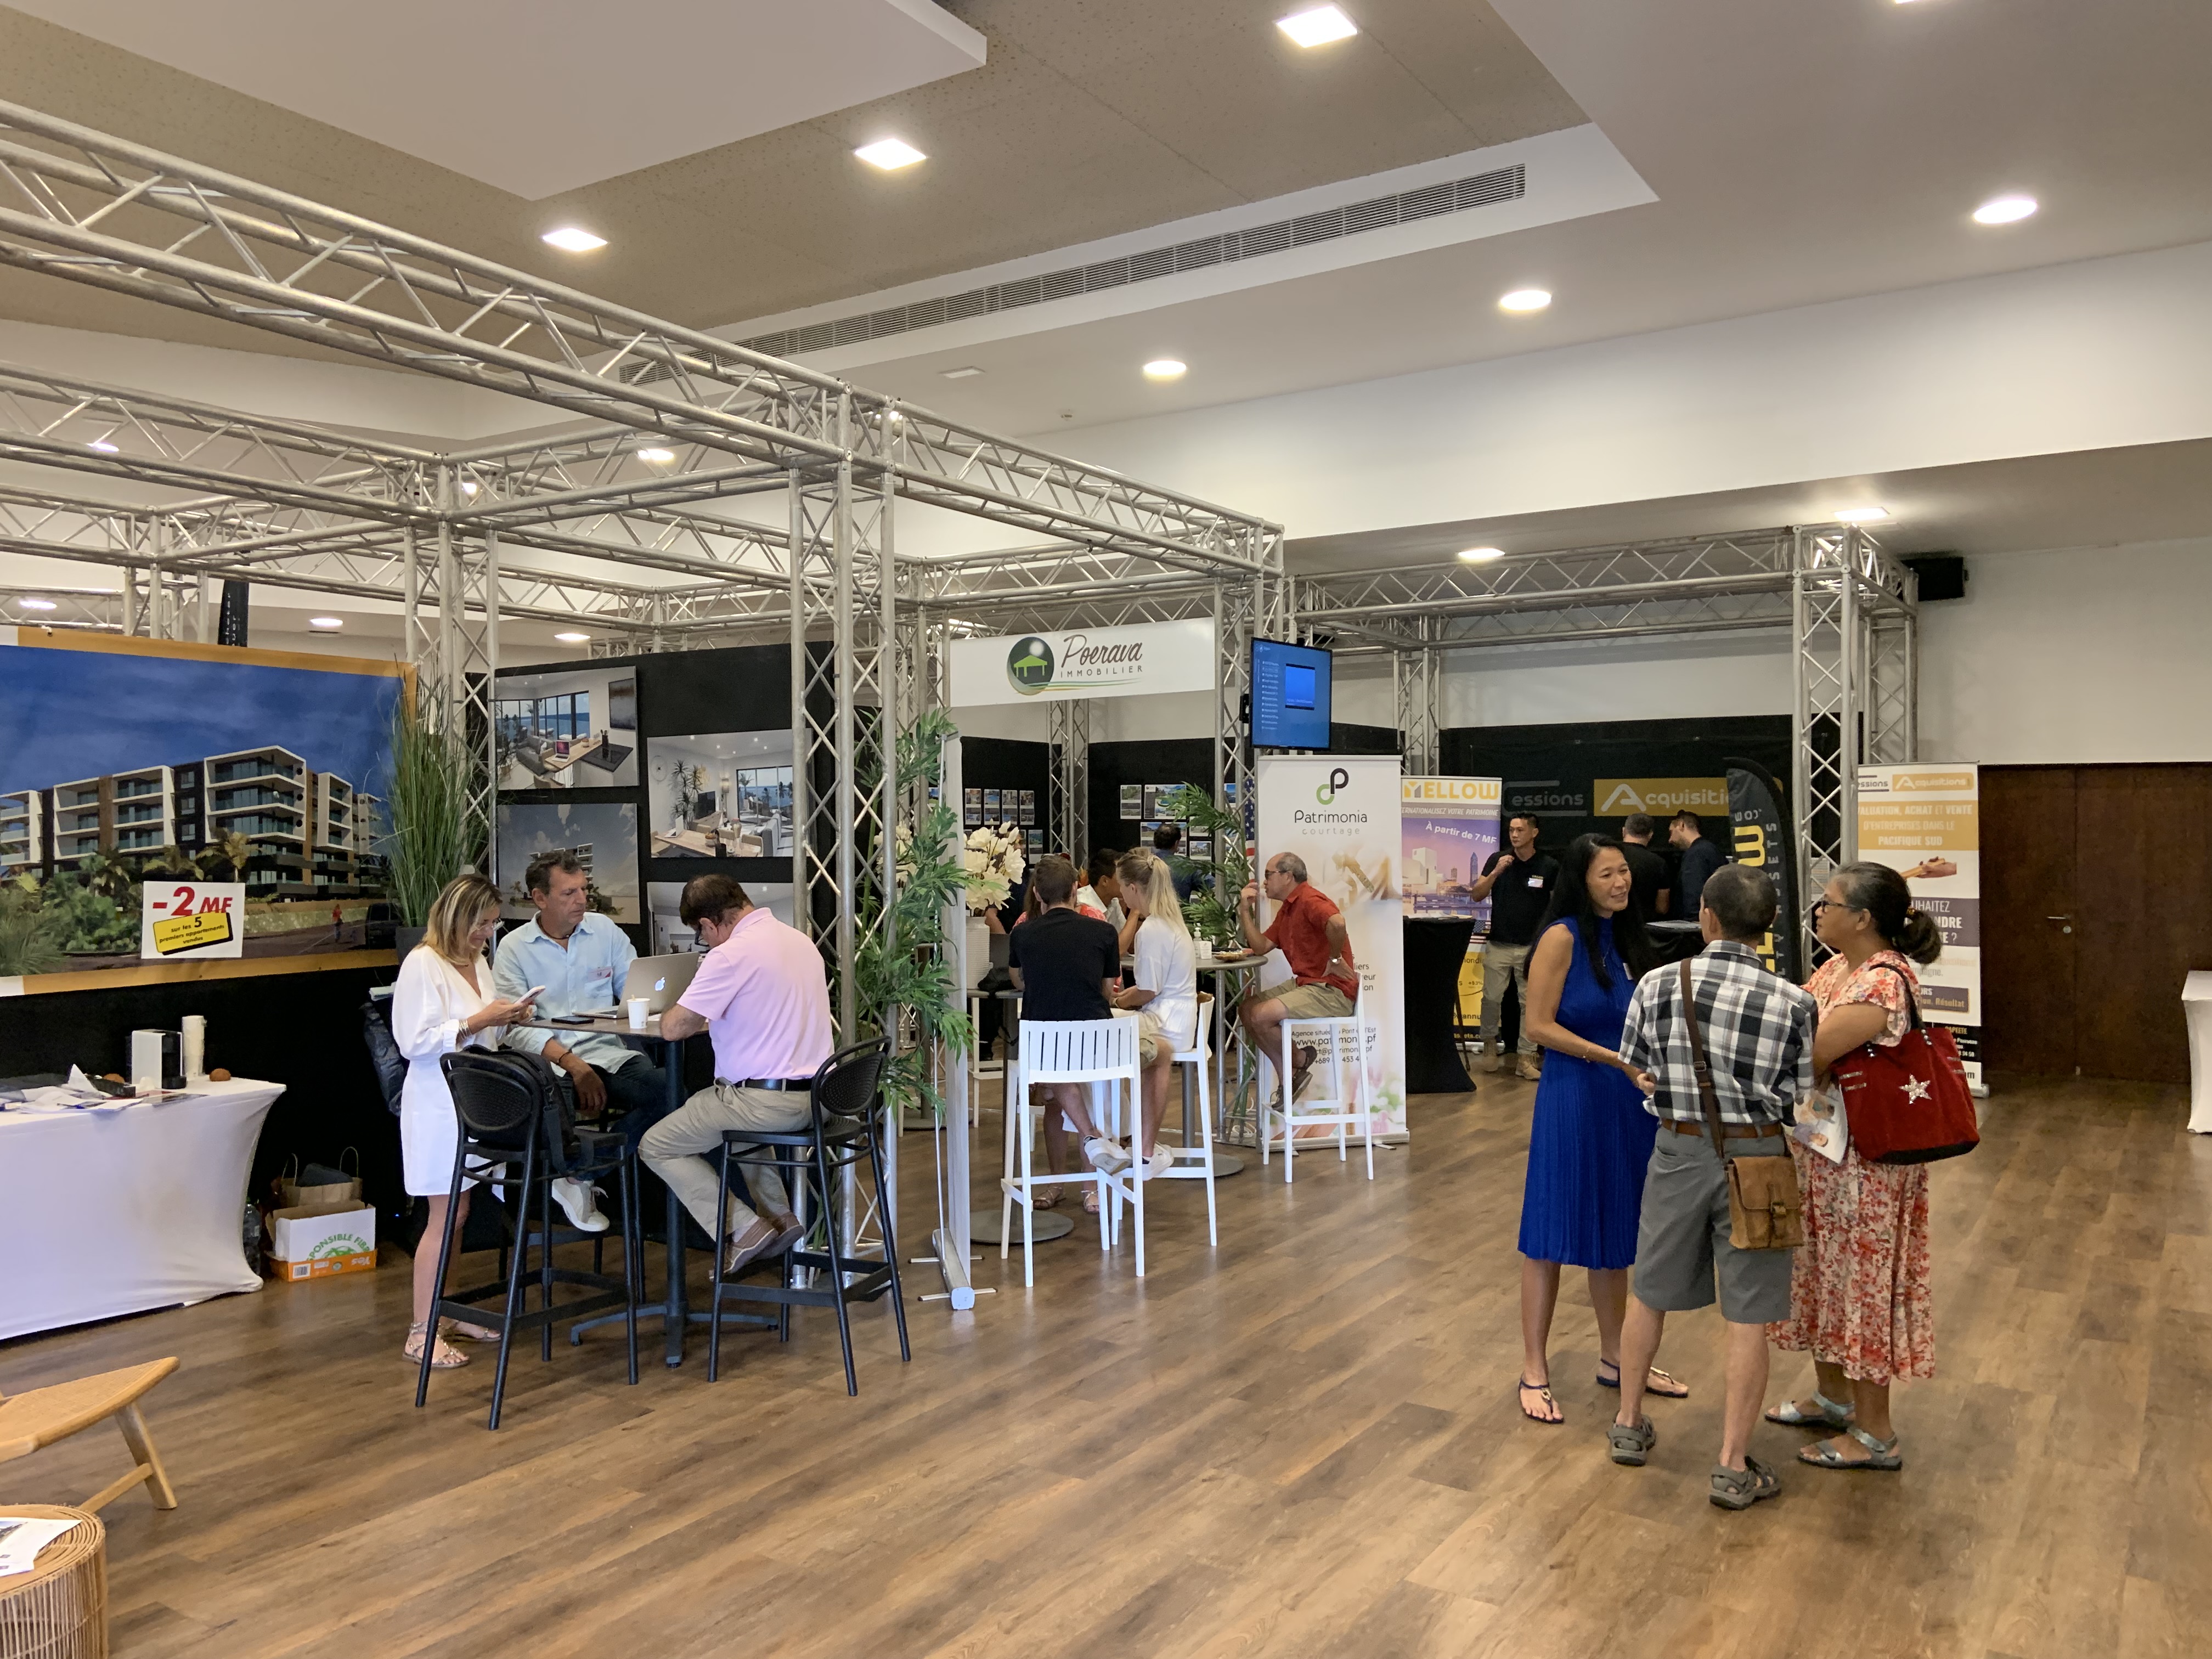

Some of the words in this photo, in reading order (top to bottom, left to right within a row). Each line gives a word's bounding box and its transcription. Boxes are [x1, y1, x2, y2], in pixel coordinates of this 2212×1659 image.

[1060, 634, 1142, 668] Poerava
[1060, 665, 1143, 678] IMMOBILIER
[1895, 776, 1966, 790] Acquisitions
[1404, 781, 1499, 800] YELLOW
[1601, 783, 1729, 812] Acquisiti
[1295, 809, 1368, 823] Patrimonia
[1905, 805, 1932, 815] ACHAT
[1946, 805, 1972, 815] VENTE
[1302, 827, 1360, 836] courtage
[1426, 821, 1432, 831] À
[1434, 826, 1460, 836] partir
[1462, 831, 1472, 839] de
[1482, 834, 1497, 844] MF
[1878, 836, 1922, 846] PACIFIQUE
[1925, 836, 1943, 846] SUD
[199, 897, 233, 913] MF
[1911, 900, 1950, 913] UHAITEZ
[194, 916, 202, 928] 5
[160, 934, 184, 944] premiers
[186, 924, 224, 937] appartements
